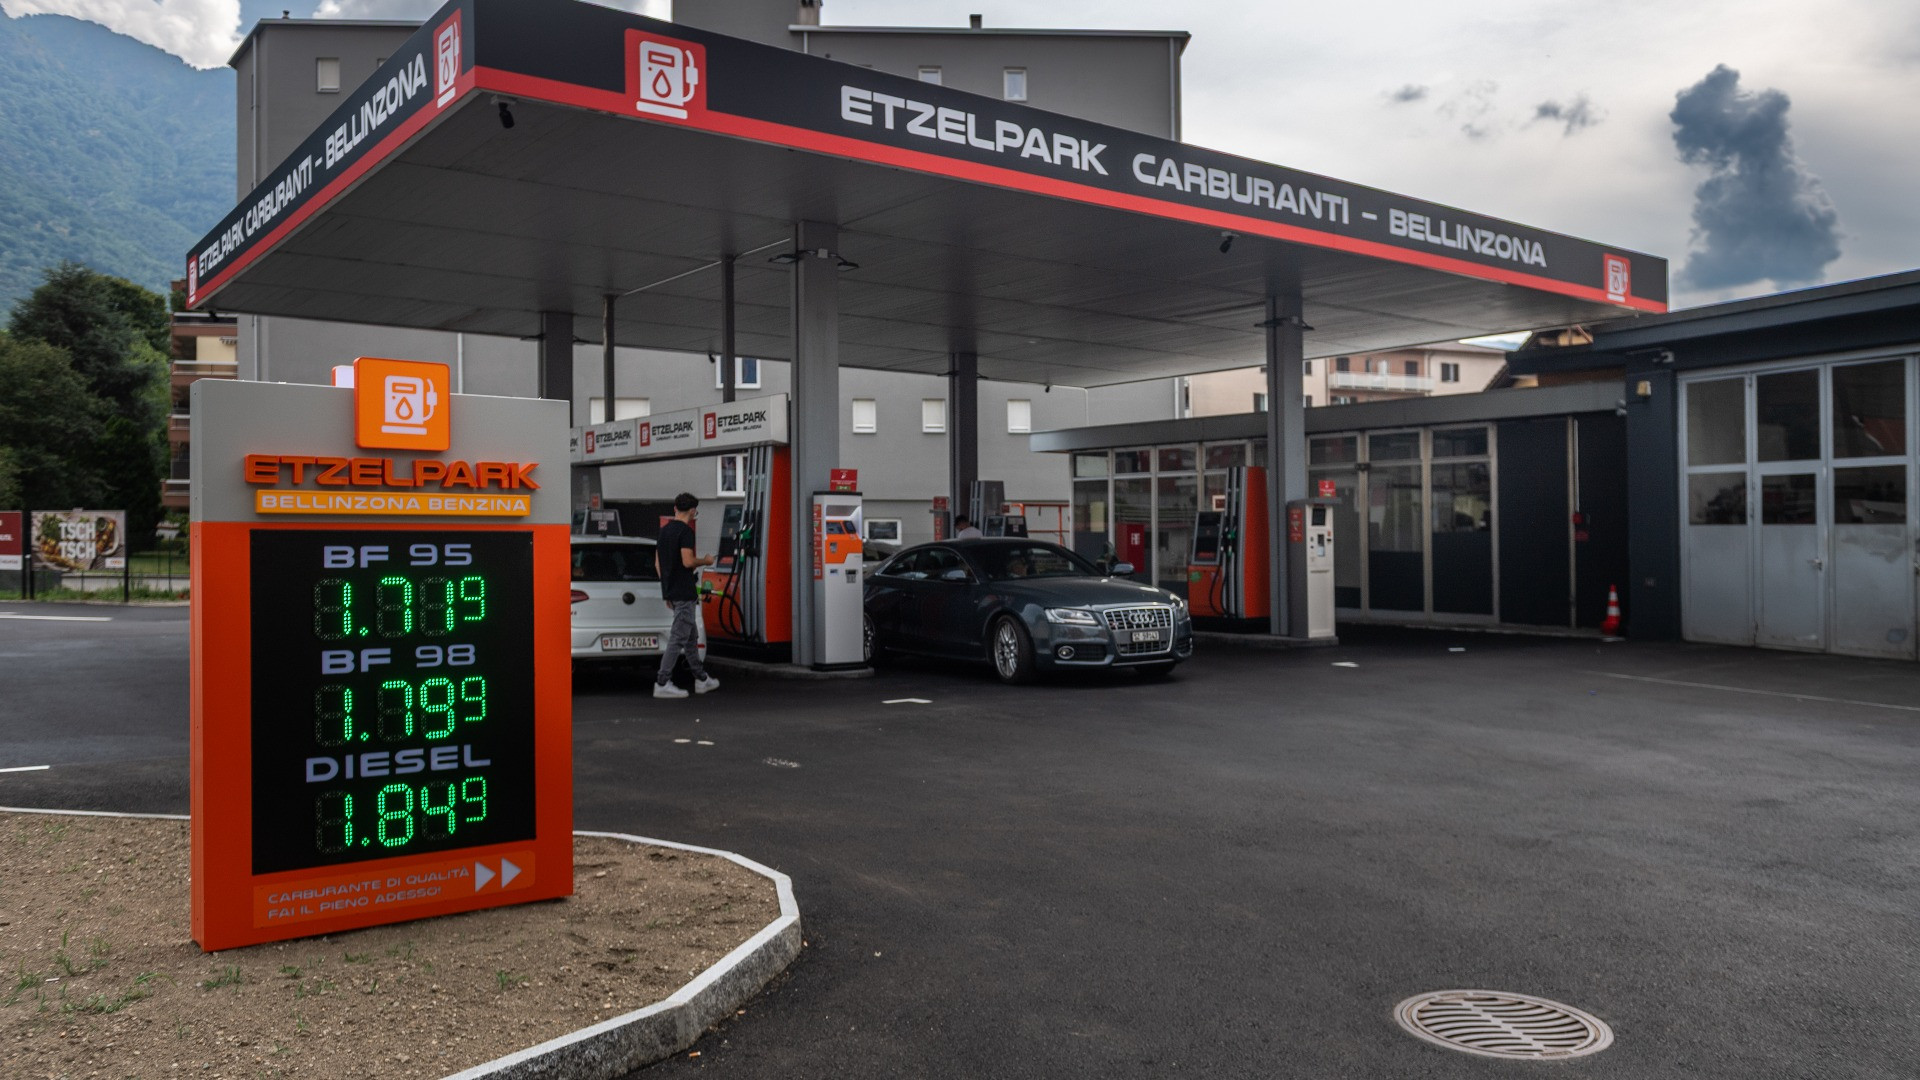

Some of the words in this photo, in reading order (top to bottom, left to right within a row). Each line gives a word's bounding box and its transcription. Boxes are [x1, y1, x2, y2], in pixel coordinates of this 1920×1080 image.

[199, 217, 245, 278] ETZELPARK
[245, 154, 312, 238] CARBURANTI
[326, 53, 427, 170] BELLINZONA
[841, 85, 1109, 176] ETZELPARK
[1132, 153, 1350, 225] CARBURANTI
[1362, 211, 1377, 221] -
[1389, 208, 1547, 267] BELLINZONA
[652, 421, 694, 436] ETZELPARK
[718, 410, 766, 427] ETZELPARK
[596, 430, 632, 444] ETZELPARK
[244, 454, 541, 489] ETZELPARK
[261, 495, 420, 511] BELLINZONA
[428, 497, 527, 512] BENZINA
[58, 522, 96, 540] TSCH
[58, 541, 96, 559] TSCH
[323, 545, 389, 569] BF
[410, 543, 472, 566] 95
[609, 638, 618, 648] TI
[321, 648, 391, 675] BF
[415, 644, 476, 668] 98
[305, 744, 491, 783] DIESEL
[268, 880, 381, 904] CARBURANTE
[387, 877, 400, 888] DI
[405, 866, 470, 885] QUALITÀ
[268, 906, 294, 919] FAI
[300, 904, 314, 915] IL
[319, 896, 369, 912] PIENO
[374, 886, 441, 904] ADESSO!
